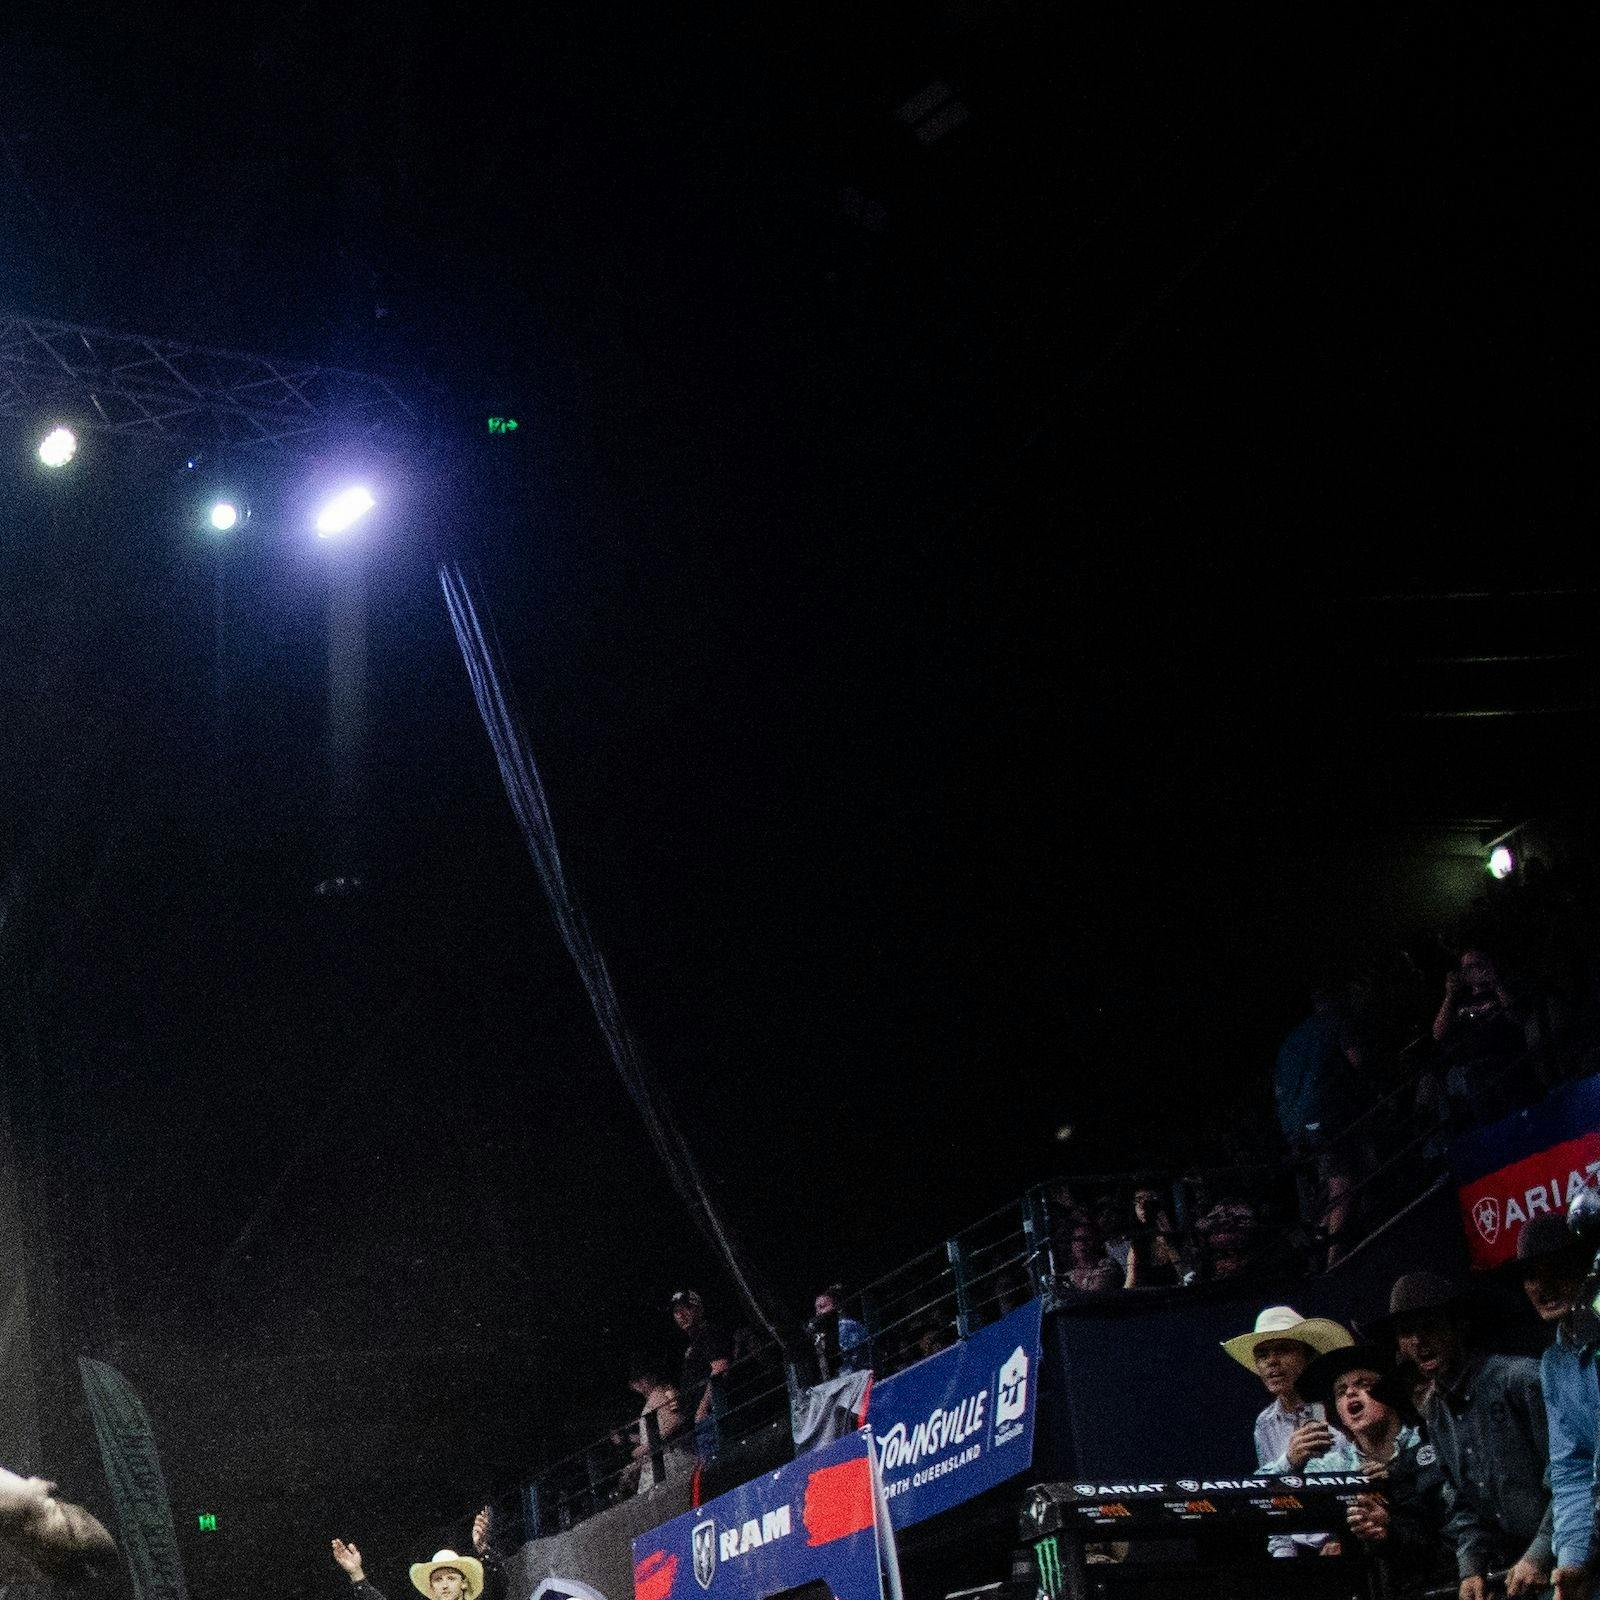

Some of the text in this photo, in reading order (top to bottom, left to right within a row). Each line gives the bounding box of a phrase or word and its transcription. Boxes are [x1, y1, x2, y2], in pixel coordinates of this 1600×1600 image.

[876, 1390, 988, 1475] TOWNSVILLE
[883, 1444, 981, 1499] ORTH QUEENSLAND
[1098, 1483, 1167, 1494] ARIAT
[1202, 1479, 1271, 1490] ARIAT
[719, 1504, 791, 1562] RAM
